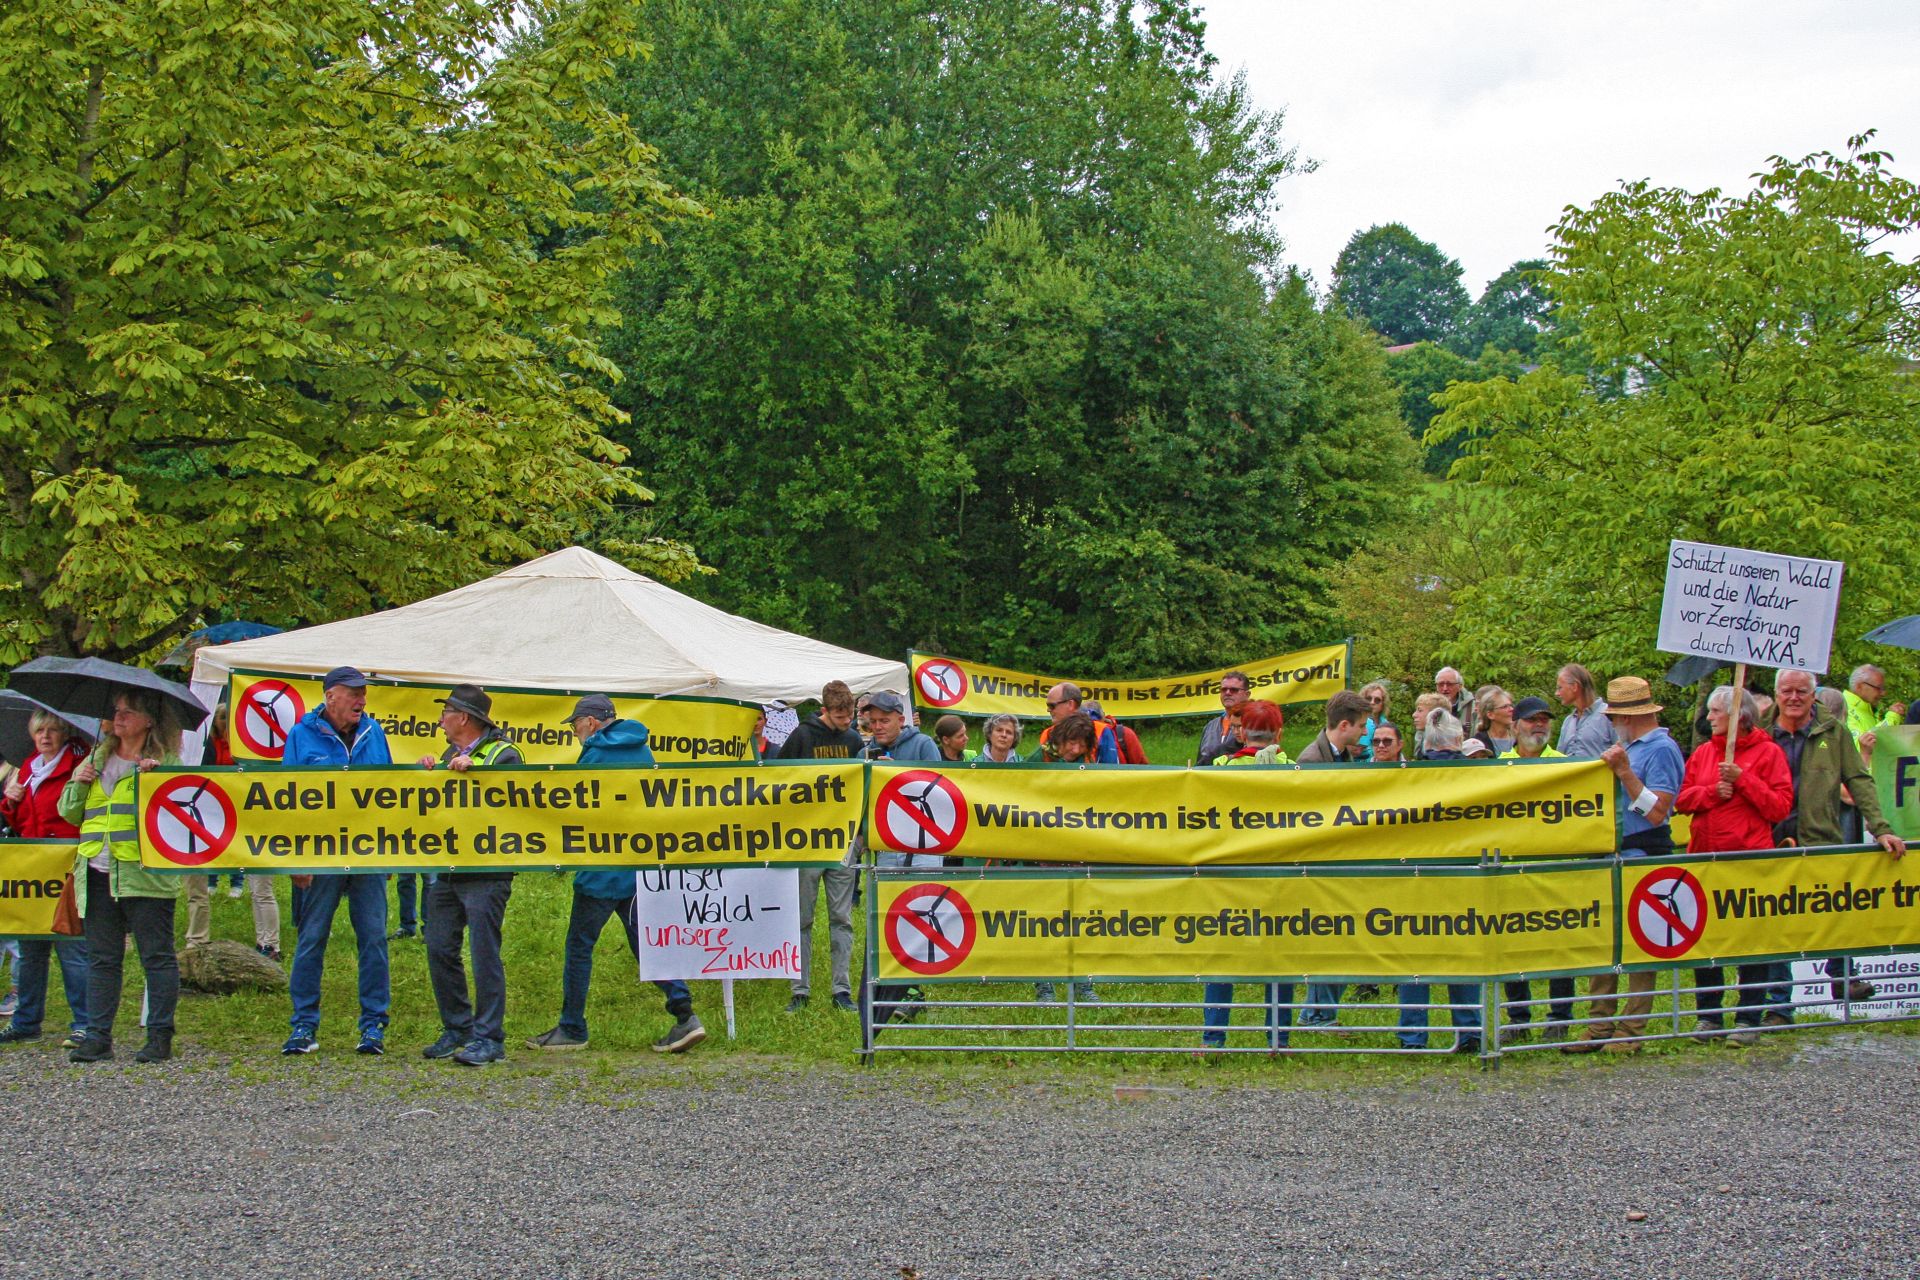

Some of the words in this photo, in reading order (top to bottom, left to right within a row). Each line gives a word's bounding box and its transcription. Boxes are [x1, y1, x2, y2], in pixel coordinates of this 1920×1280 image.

[1671, 547, 1726, 574] Schützt
[1729, 562, 1780, 582] unseren
[1788, 561, 1833, 590] Wald
[1683, 579, 1711, 599] und
[1713, 580, 1739, 602] die
[1745, 584, 1799, 611] Natur
[1680, 609, 1706, 625] vor
[1706, 602, 1801, 645] Zerstörung
[1690, 632, 1734, 655] durch
[972, 674, 1119, 701] Windsom
[1127, 687, 1160, 701] ist
[1166, 658, 1341, 699] Zufasstrom!
[244, 781, 335, 811] Adel
[351, 779, 600, 816] verpflichtet!
[640, 774, 847, 808] Windkraft
[1896, 756, 1920, 807] F
[974, 803, 1168, 830] Windstrom
[1177, 805, 1221, 830] ist
[1229, 806, 1324, 830] teure
[1333, 793, 1604, 826] Armutsenergie!
[245, 826, 459, 856] vernichtet
[473, 825, 547, 855] das
[562, 820, 856, 860] Europadiplom!
[683, 893, 754, 924] Wald
[1713, 879, 1886, 920] Windräder
[1892, 879, 1920, 908] tr
[645, 924, 733, 947] unsere
[982, 909, 1167, 938] Windräder
[1173, 908, 1355, 944] gefährden
[1365, 899, 1601, 936] Grundwasser!
[702, 941, 801, 975] Zukunft
[1803, 985, 1825, 995] zu
